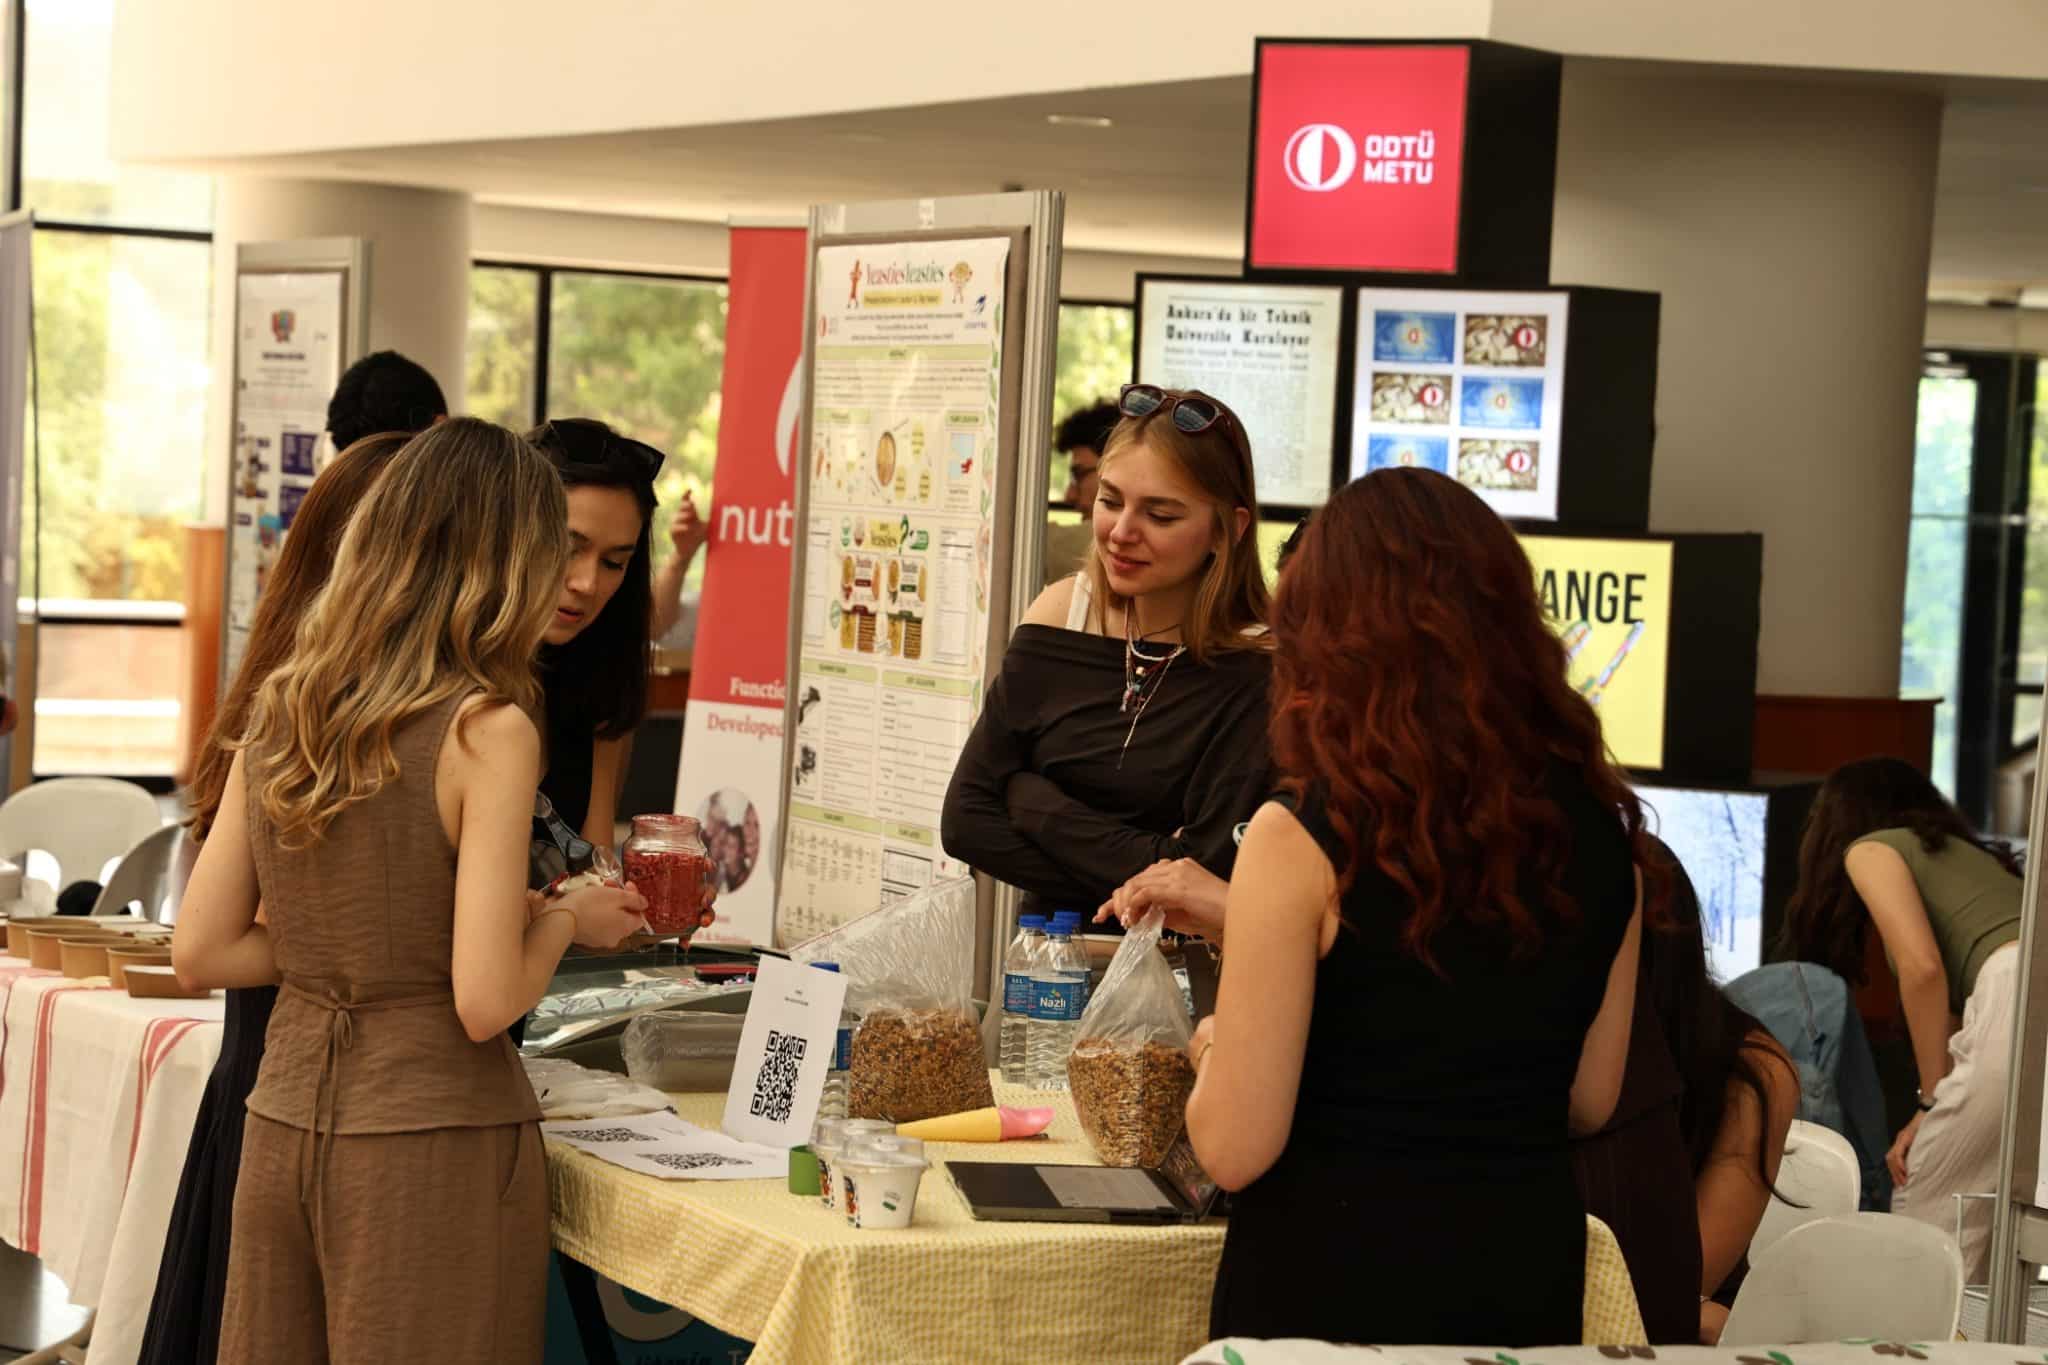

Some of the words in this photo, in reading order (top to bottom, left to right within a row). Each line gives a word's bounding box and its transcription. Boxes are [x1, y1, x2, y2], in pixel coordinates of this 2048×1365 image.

[1365, 130, 1435, 159] ODTÜ
[1363, 160, 1433, 184] METU
[1166, 304, 1231, 321] Ankara'da
[1240, 307, 1257, 322] bir
[1266, 308, 1312, 324] Teknik
[719, 500, 793, 546] nut
